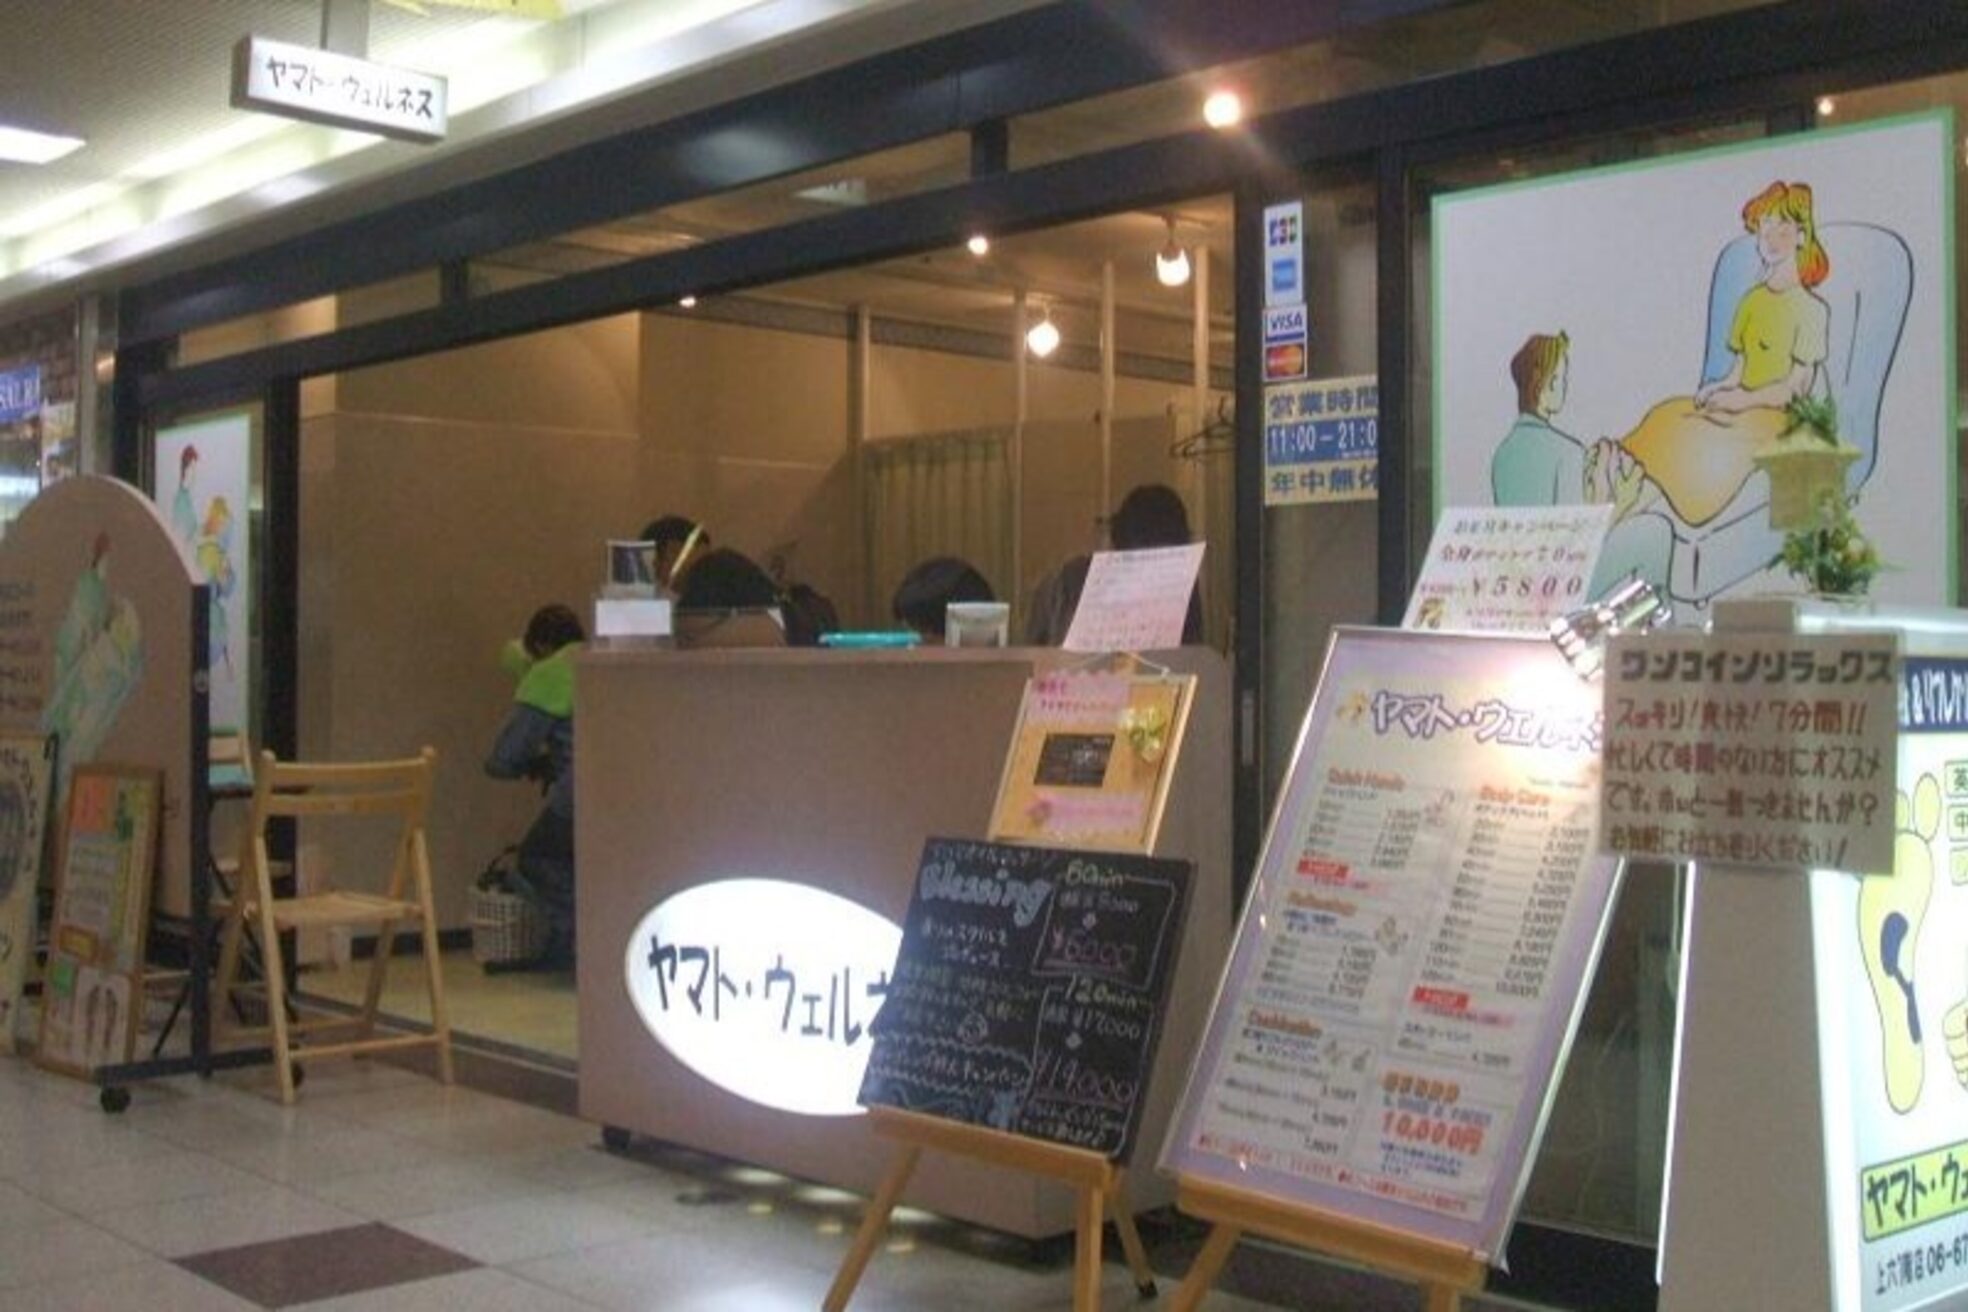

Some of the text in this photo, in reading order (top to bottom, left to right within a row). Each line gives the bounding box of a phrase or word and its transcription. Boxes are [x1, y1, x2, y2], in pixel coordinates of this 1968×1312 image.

[1270, 311, 1303, 331] VISA
[1619, 649, 1893, 684] ワンコインリラックス
